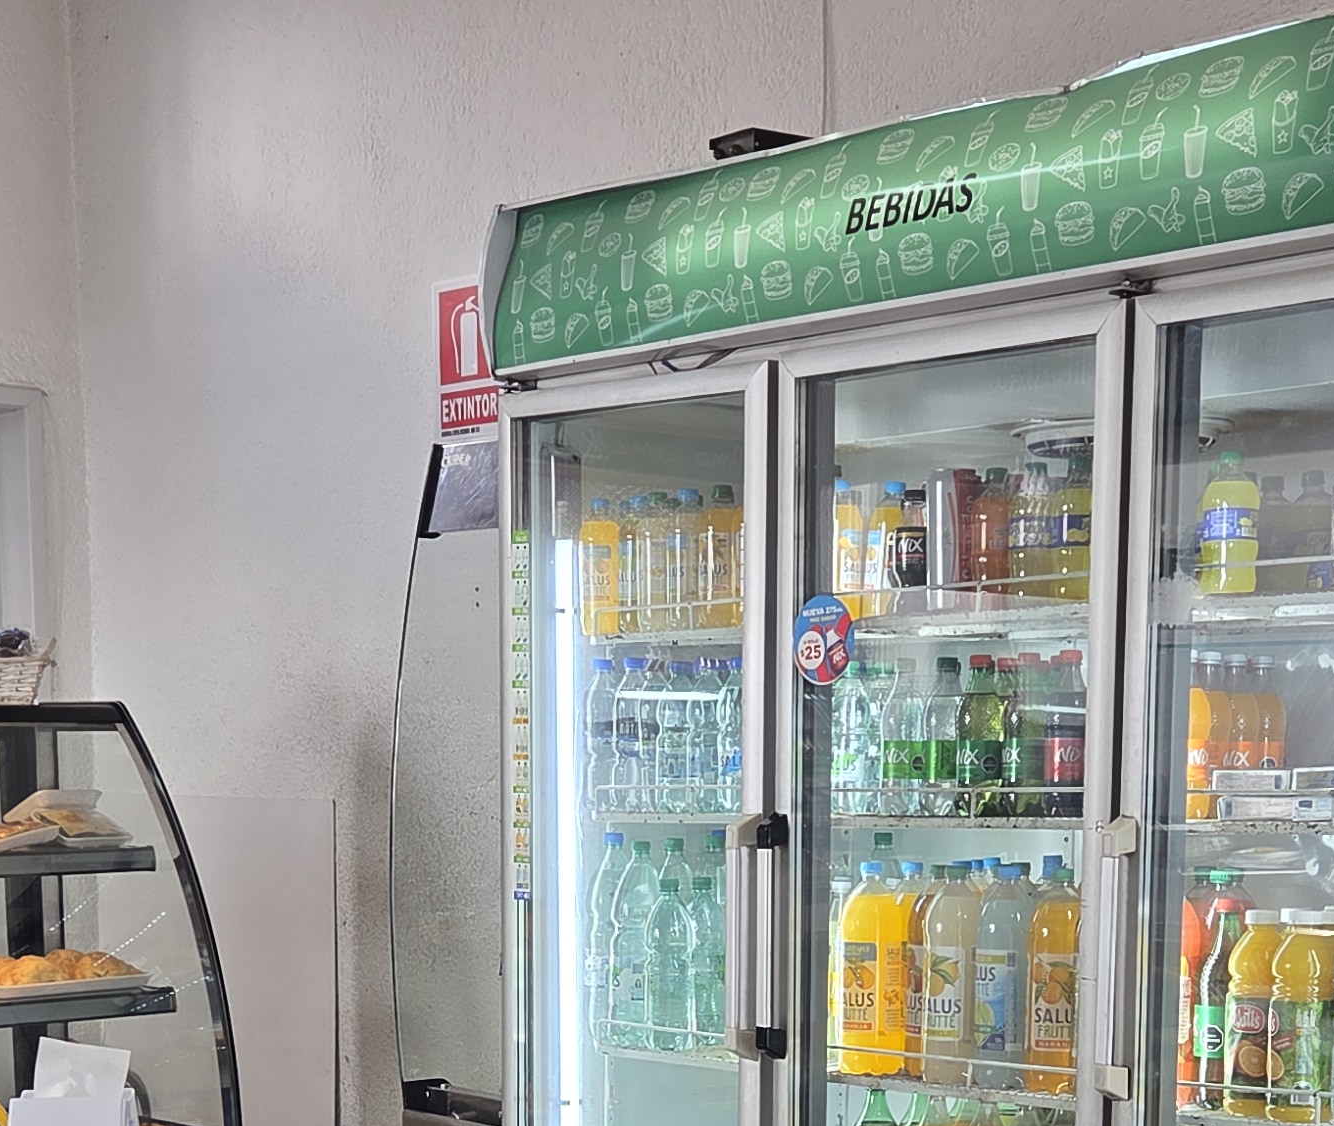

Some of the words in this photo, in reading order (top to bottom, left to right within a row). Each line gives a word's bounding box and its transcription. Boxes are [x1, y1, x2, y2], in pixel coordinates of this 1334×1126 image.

[845, 172, 978, 235] BEBIDAS
[442, 392, 498, 423] EXTINTOR
[976, 965, 997, 981] LUS
[923, 999, 962, 1015] ALUS
[1034, 1007, 1072, 1024] SALU
